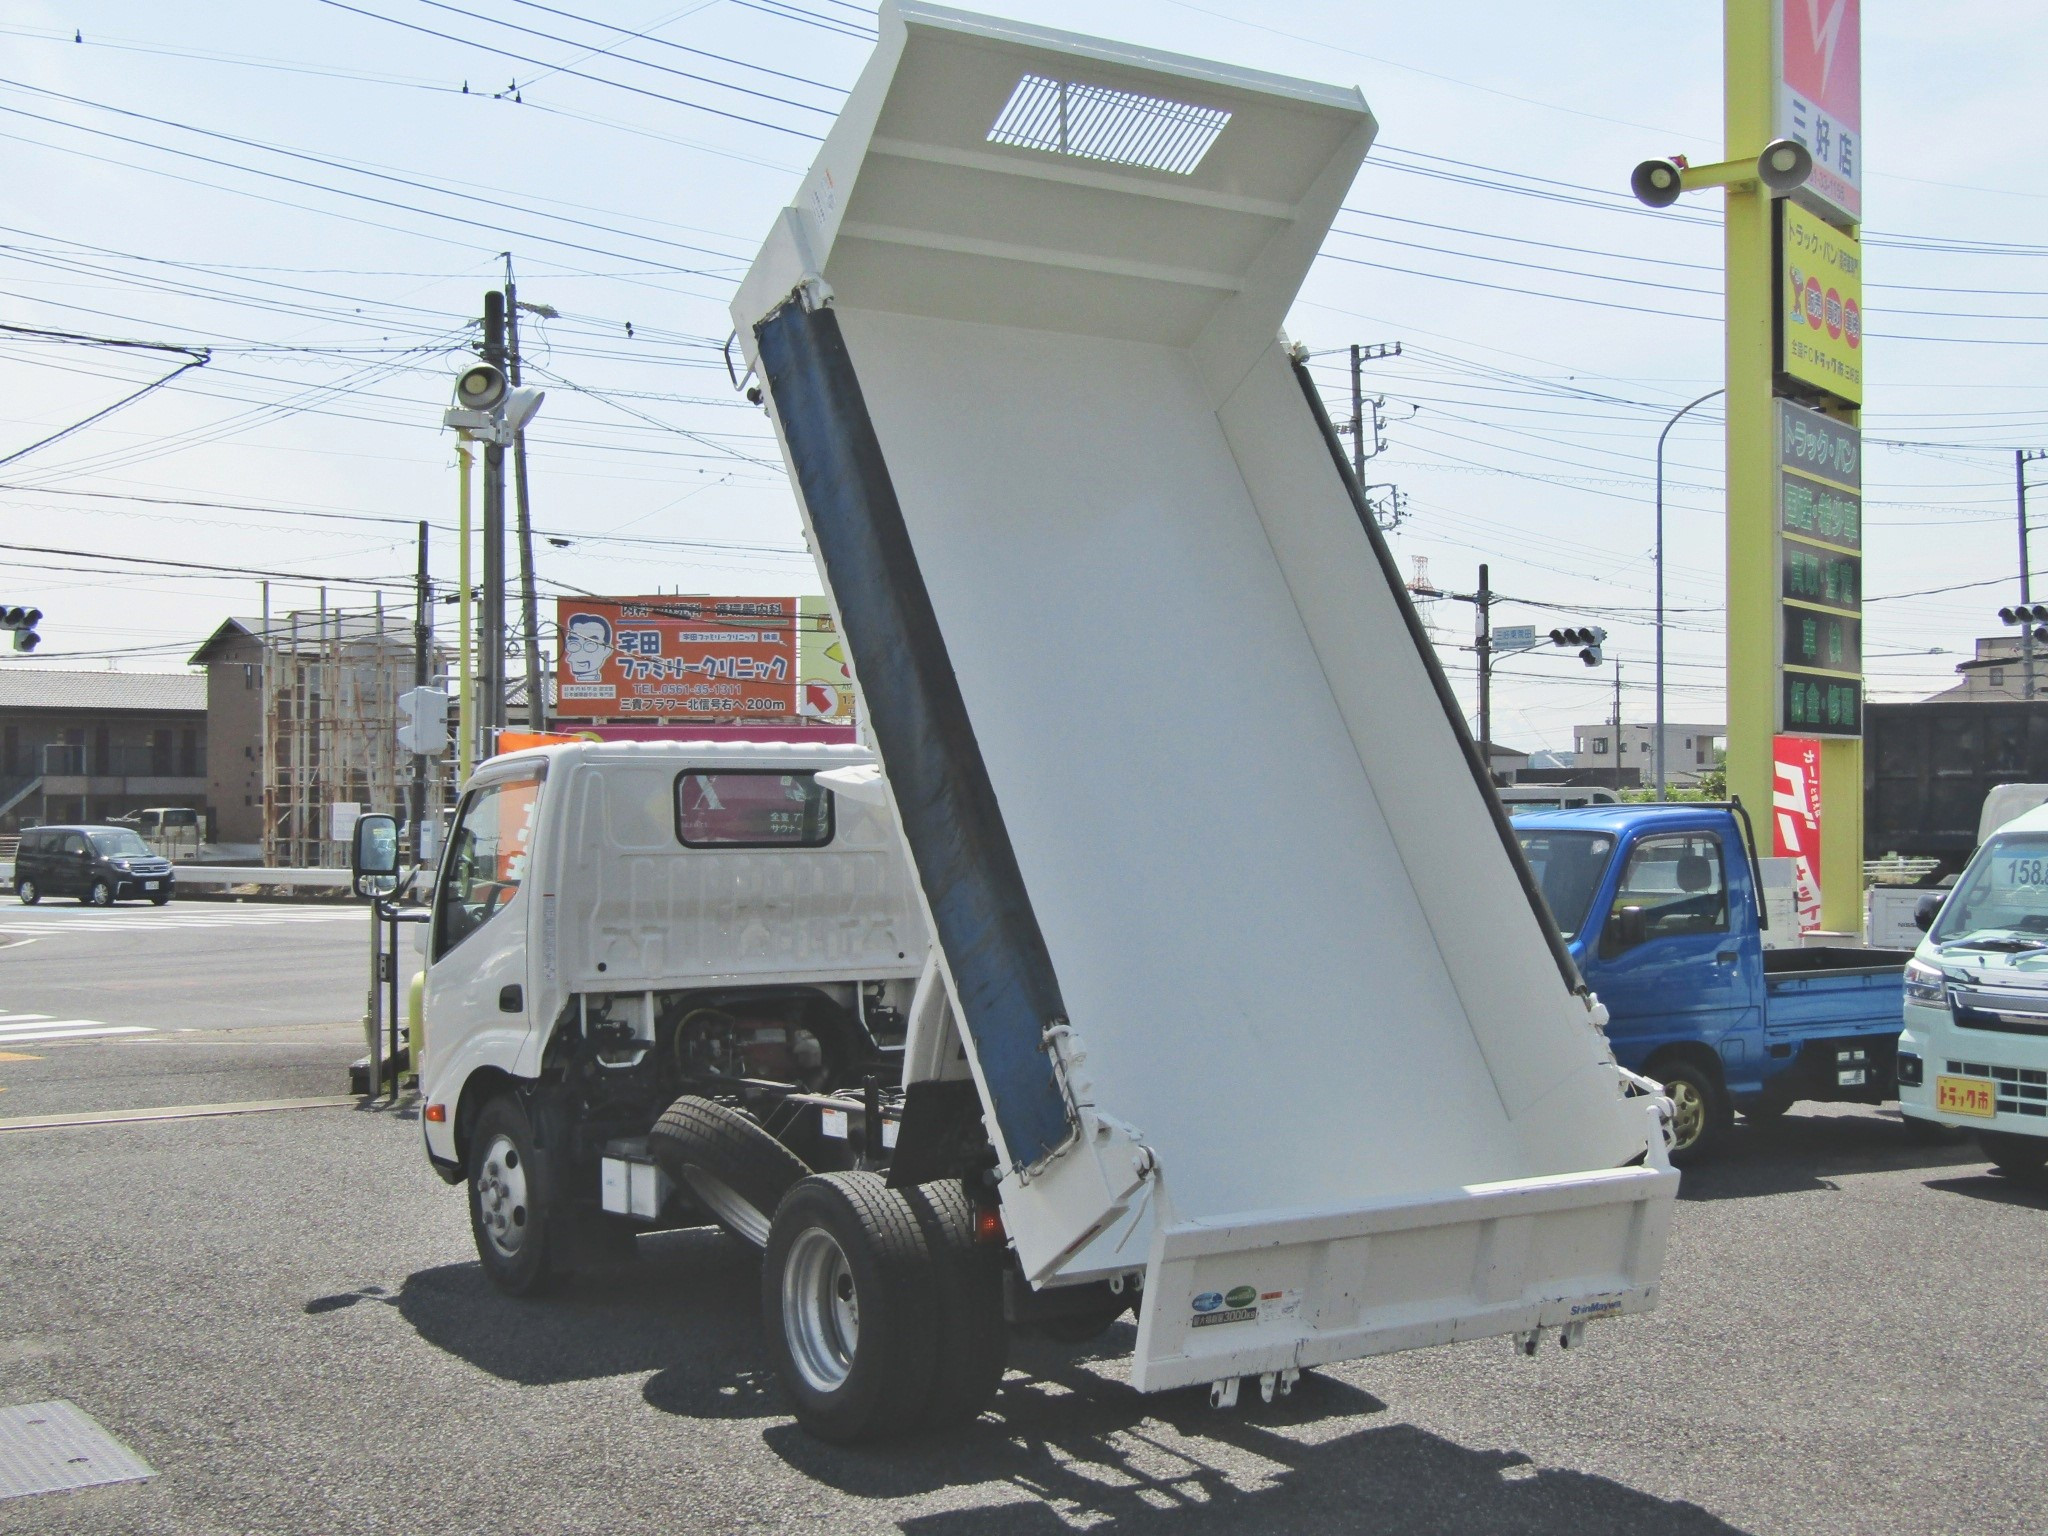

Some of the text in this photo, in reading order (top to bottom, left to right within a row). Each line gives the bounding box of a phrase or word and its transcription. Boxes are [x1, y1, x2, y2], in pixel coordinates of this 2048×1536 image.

[1792, 98, 1852, 178] 三好店
[1784, 414, 1857, 474] トラック・バン
[616, 630, 661, 655] 宇田
[682, 632, 780, 642] 宇田ファミリークリニック 検索
[616, 655, 788, 681] ファミリークリニック
[747, 698, 785, 711] 200m
[1940, 1085, 1989, 1110] トラック市
